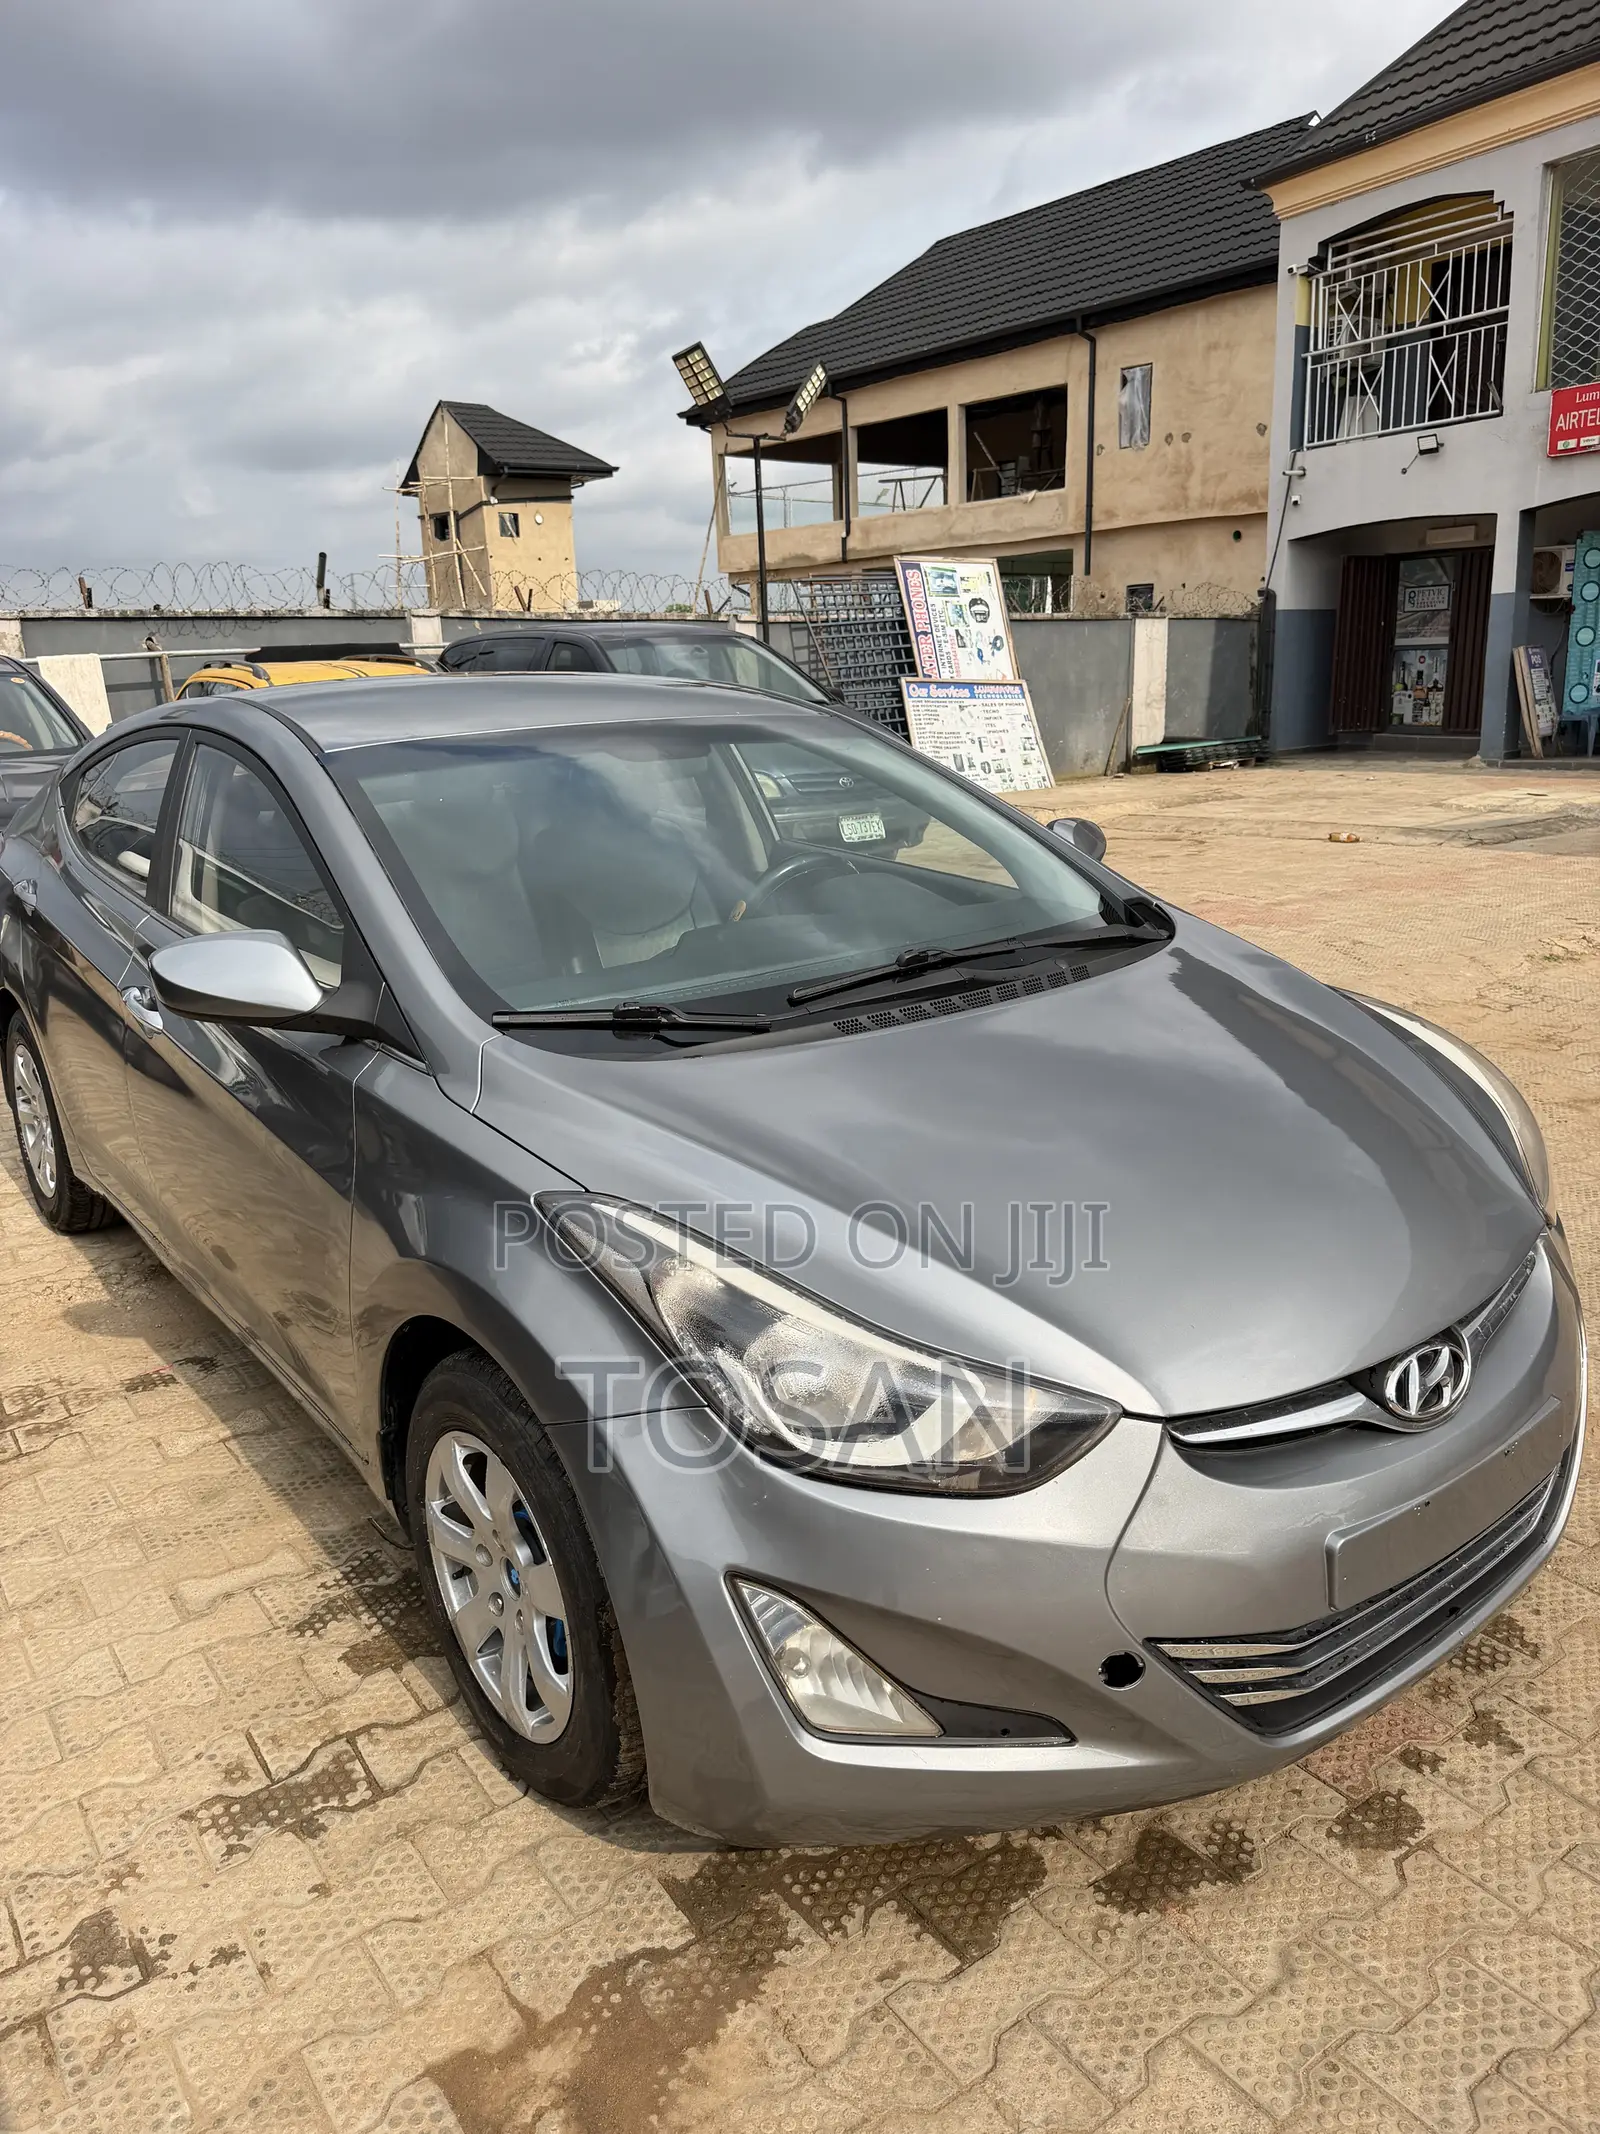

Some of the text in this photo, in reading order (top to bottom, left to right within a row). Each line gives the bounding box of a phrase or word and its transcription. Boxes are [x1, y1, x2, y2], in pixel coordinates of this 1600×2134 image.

[906, 569, 939, 680] ATER PHONES
[930, 603, 947, 669] INTERNET DEVICES
[945, 651, 955, 674] CARDS
[929, 684, 970, 698] Services
